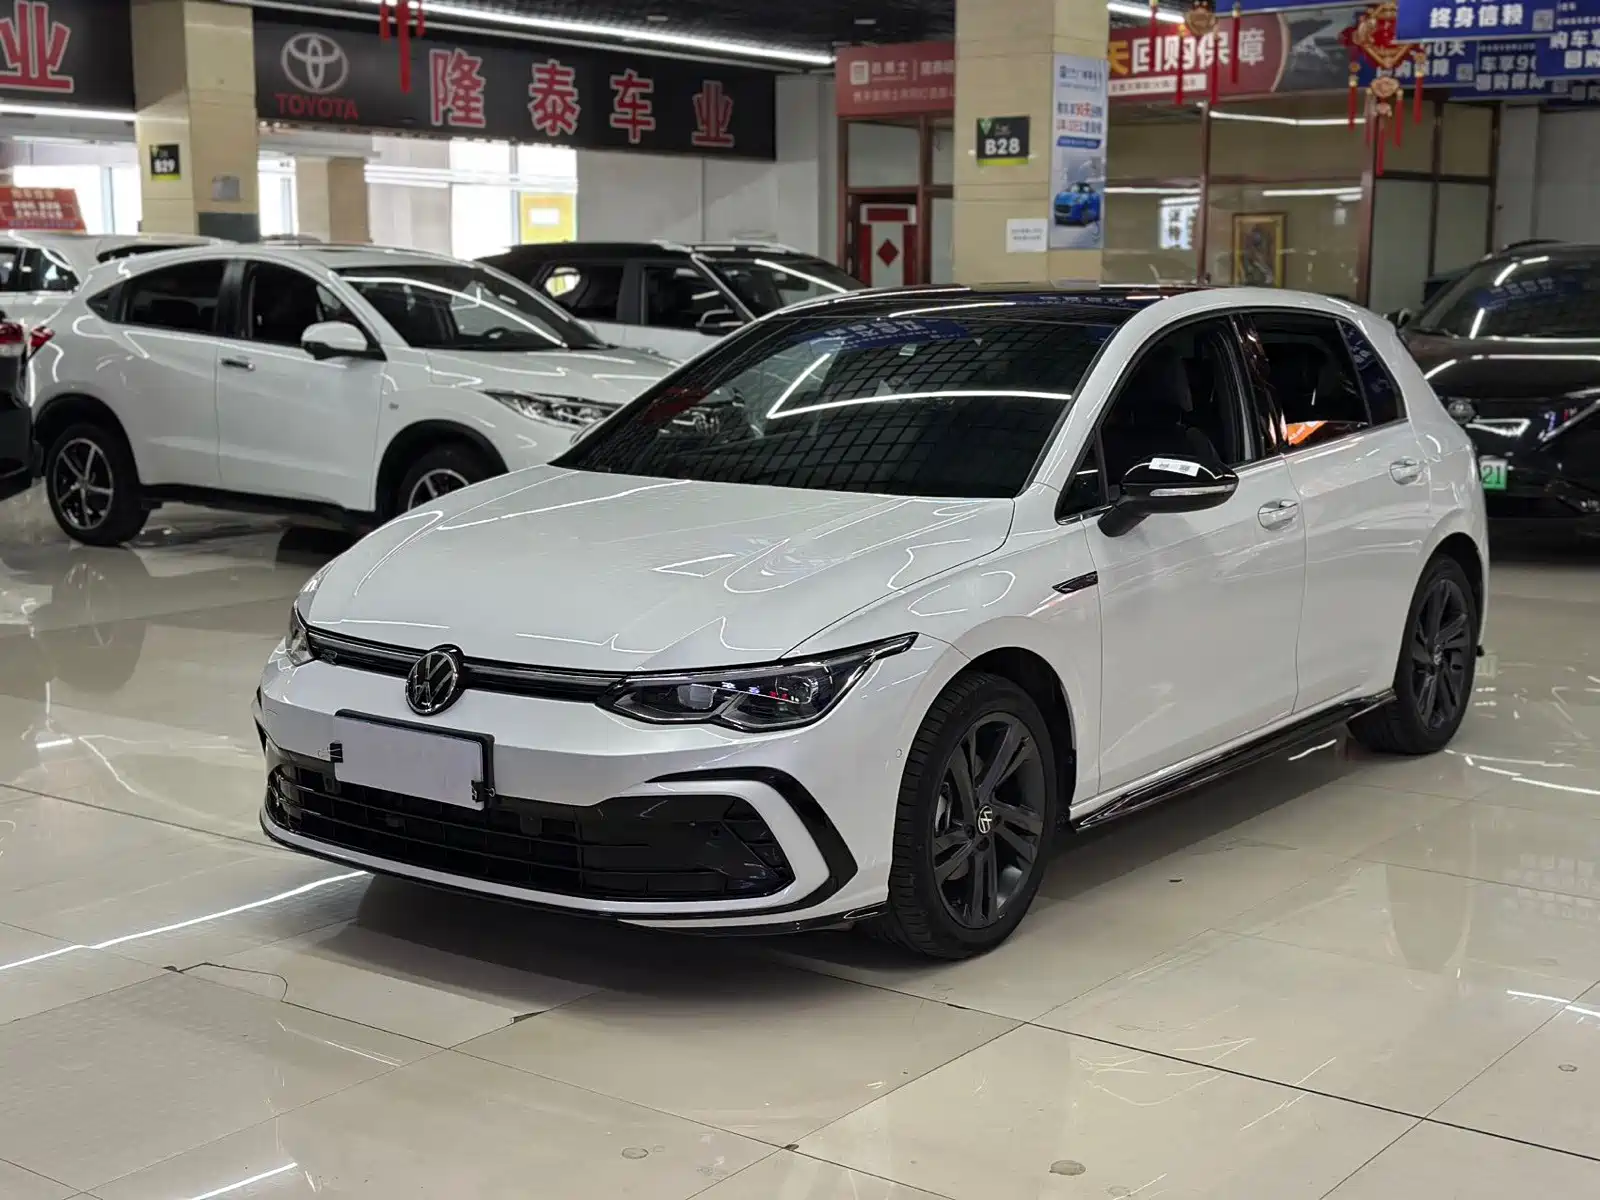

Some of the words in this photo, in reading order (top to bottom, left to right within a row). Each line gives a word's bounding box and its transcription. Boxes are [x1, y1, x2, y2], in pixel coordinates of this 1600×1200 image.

[1429, 4, 1523, 29] 终身信赖
[0, 1, 74, 93] 业
[275, 92, 359, 121] TOYOTA
[428, 47, 735, 149] 隆泰车业
[984, 137, 1021, 156] B28
